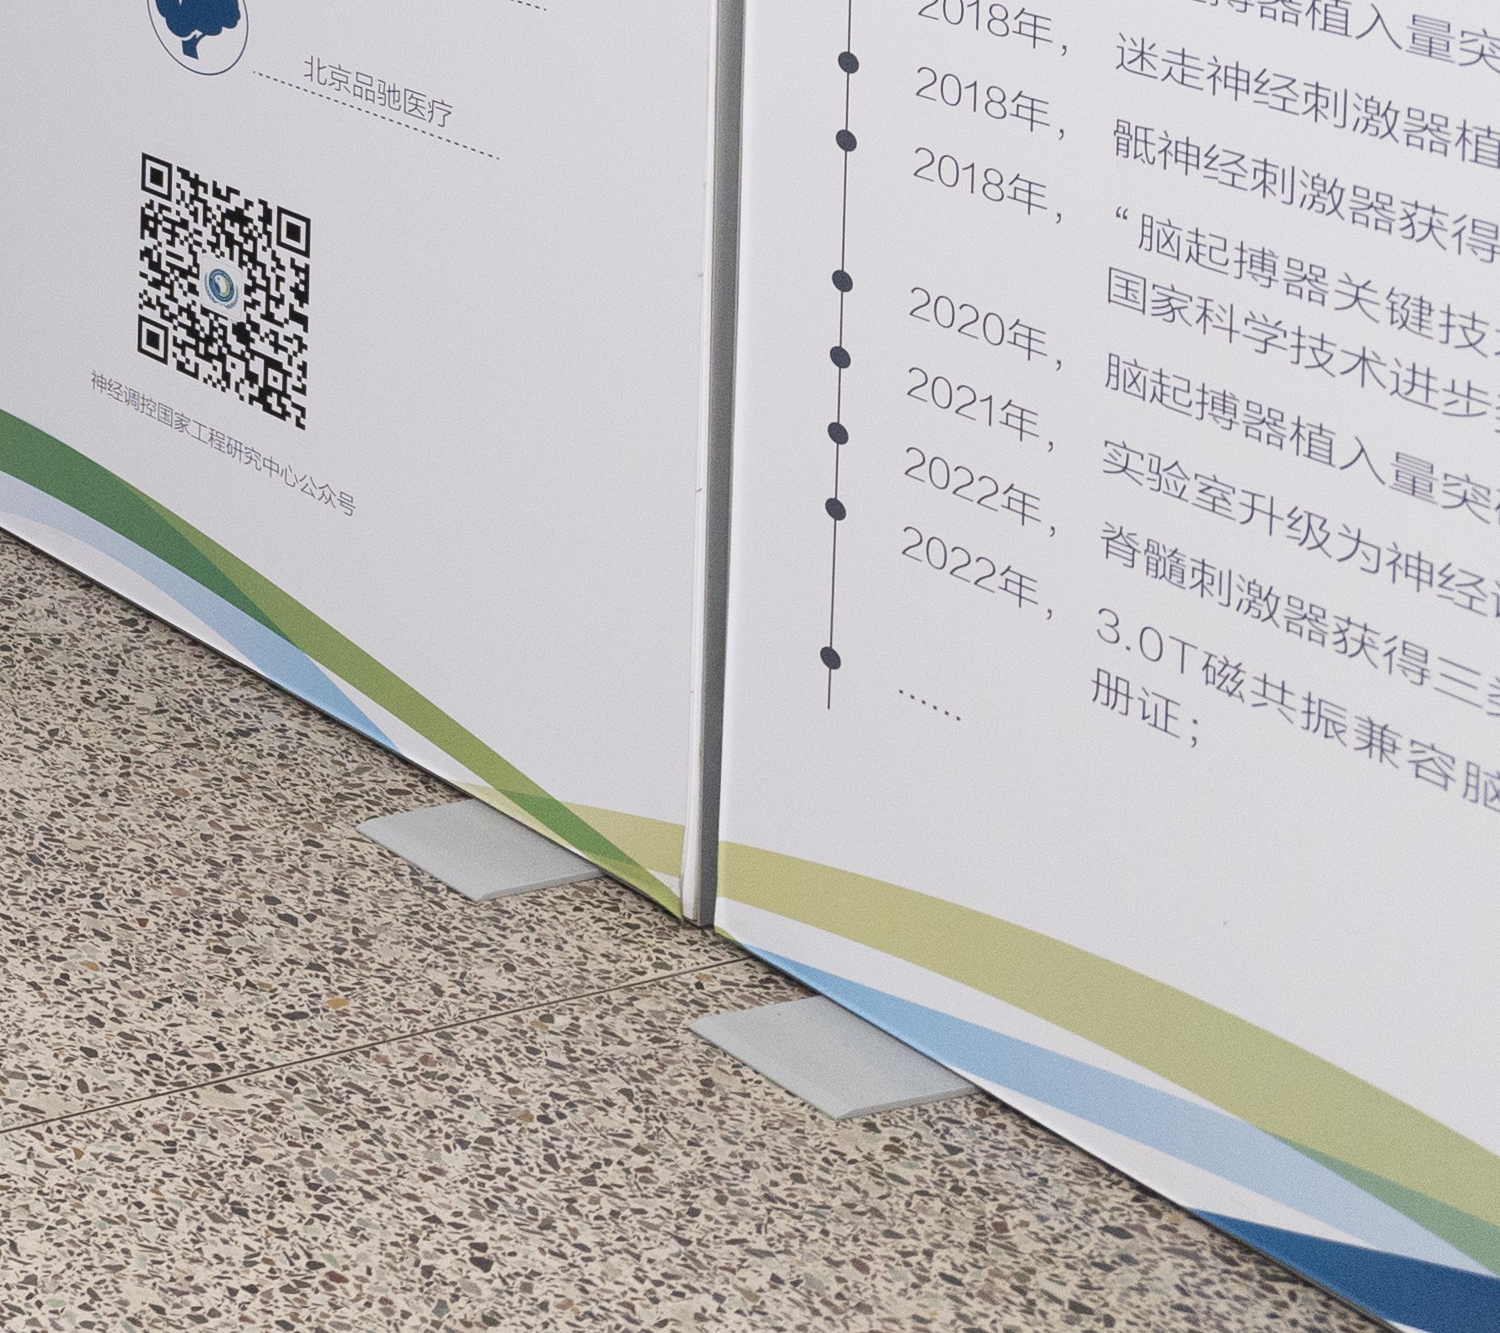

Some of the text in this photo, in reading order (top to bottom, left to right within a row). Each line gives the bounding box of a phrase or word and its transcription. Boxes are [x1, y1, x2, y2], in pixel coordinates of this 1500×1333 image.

[303, 54, 454, 129] 北京品驰医疗
[1106, 265, 1500, 435] 国家科学技术进步
[1114, 205, 1500, 359] “脑起搏器关键技
[90, 370, 356, 517] 神经调控国家工程研究中心公众号
[1104, 351, 1500, 525] 脑起搏器植入量突
[1102, 439, 1500, 619] 实验室升级为神经
[1100, 520, 1500, 718] 脊髓刺激器获得三
[1090, 666, 1199, 749] 册证；
